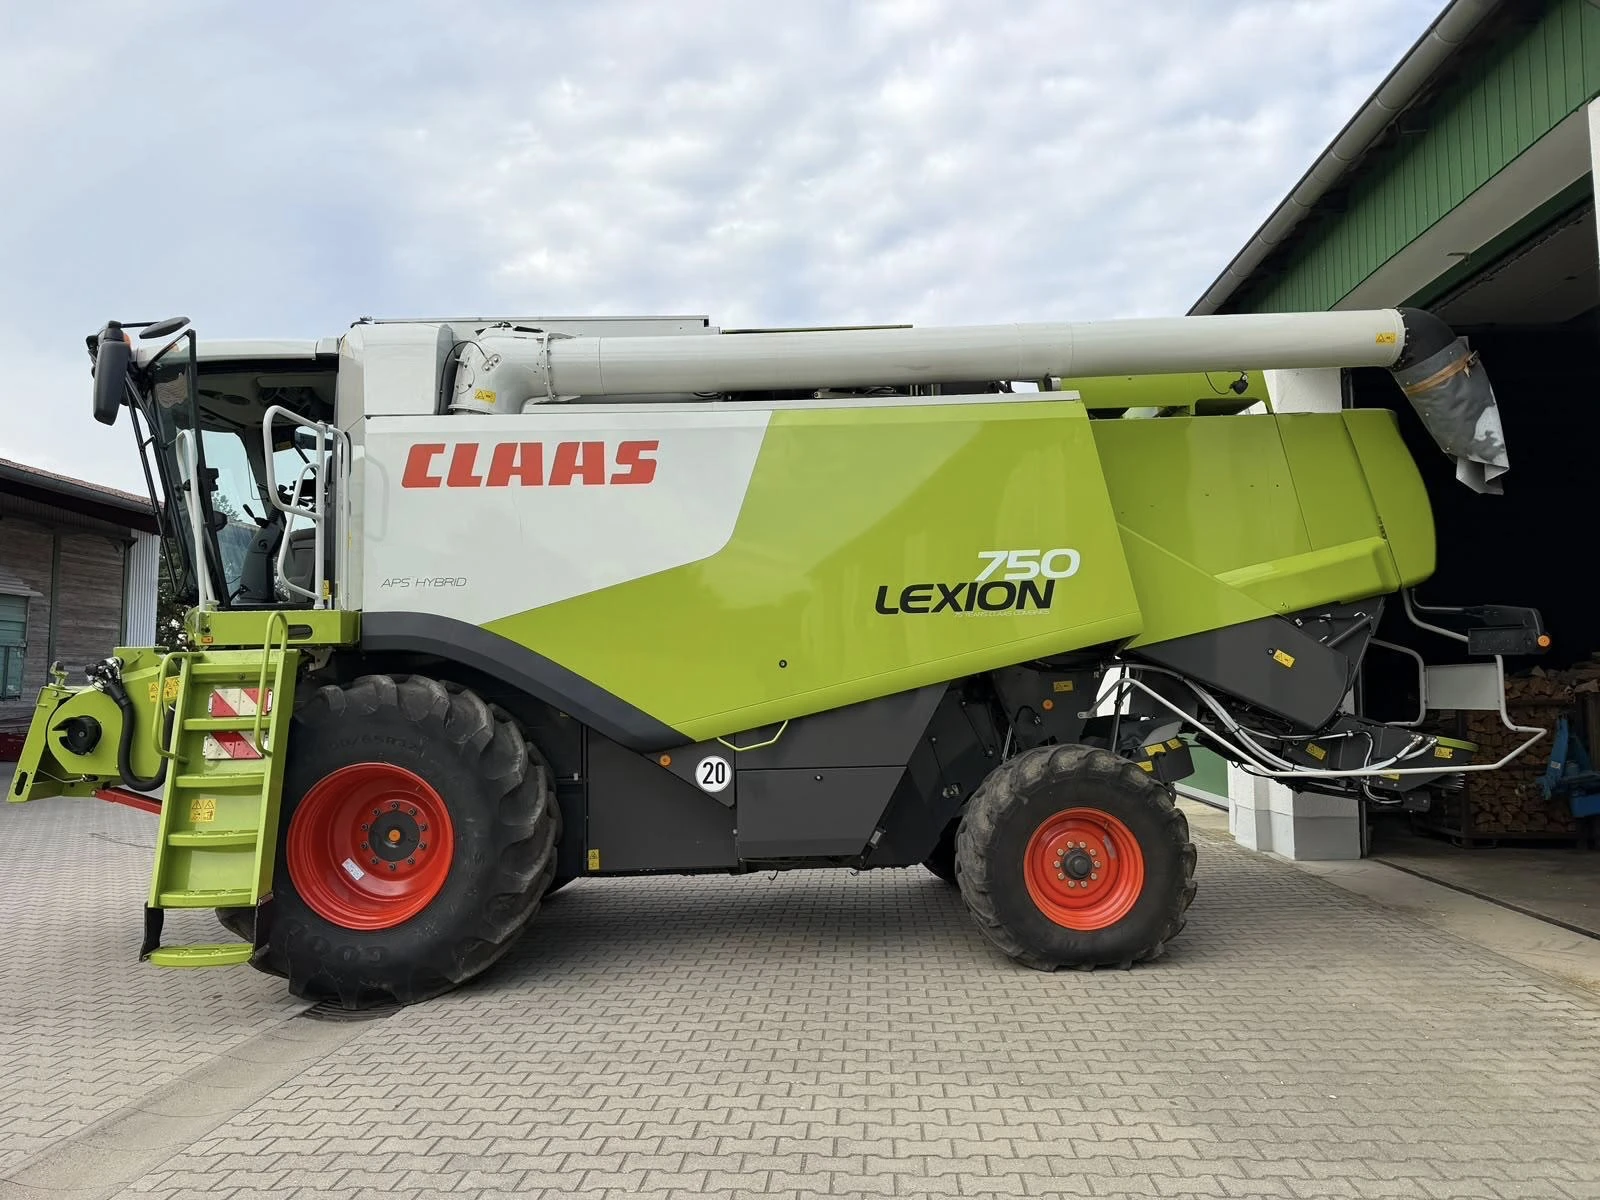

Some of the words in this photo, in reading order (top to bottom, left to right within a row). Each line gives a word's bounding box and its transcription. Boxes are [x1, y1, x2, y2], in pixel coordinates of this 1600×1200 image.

[401, 440, 660, 488] CLAAS
[380, 577, 411, 588] APS
[415, 576, 467, 588] HYBRID
[975, 548, 1081, 582] 750
[875, 579, 1056, 615] LEXION
[702, 761, 726, 785] 20
